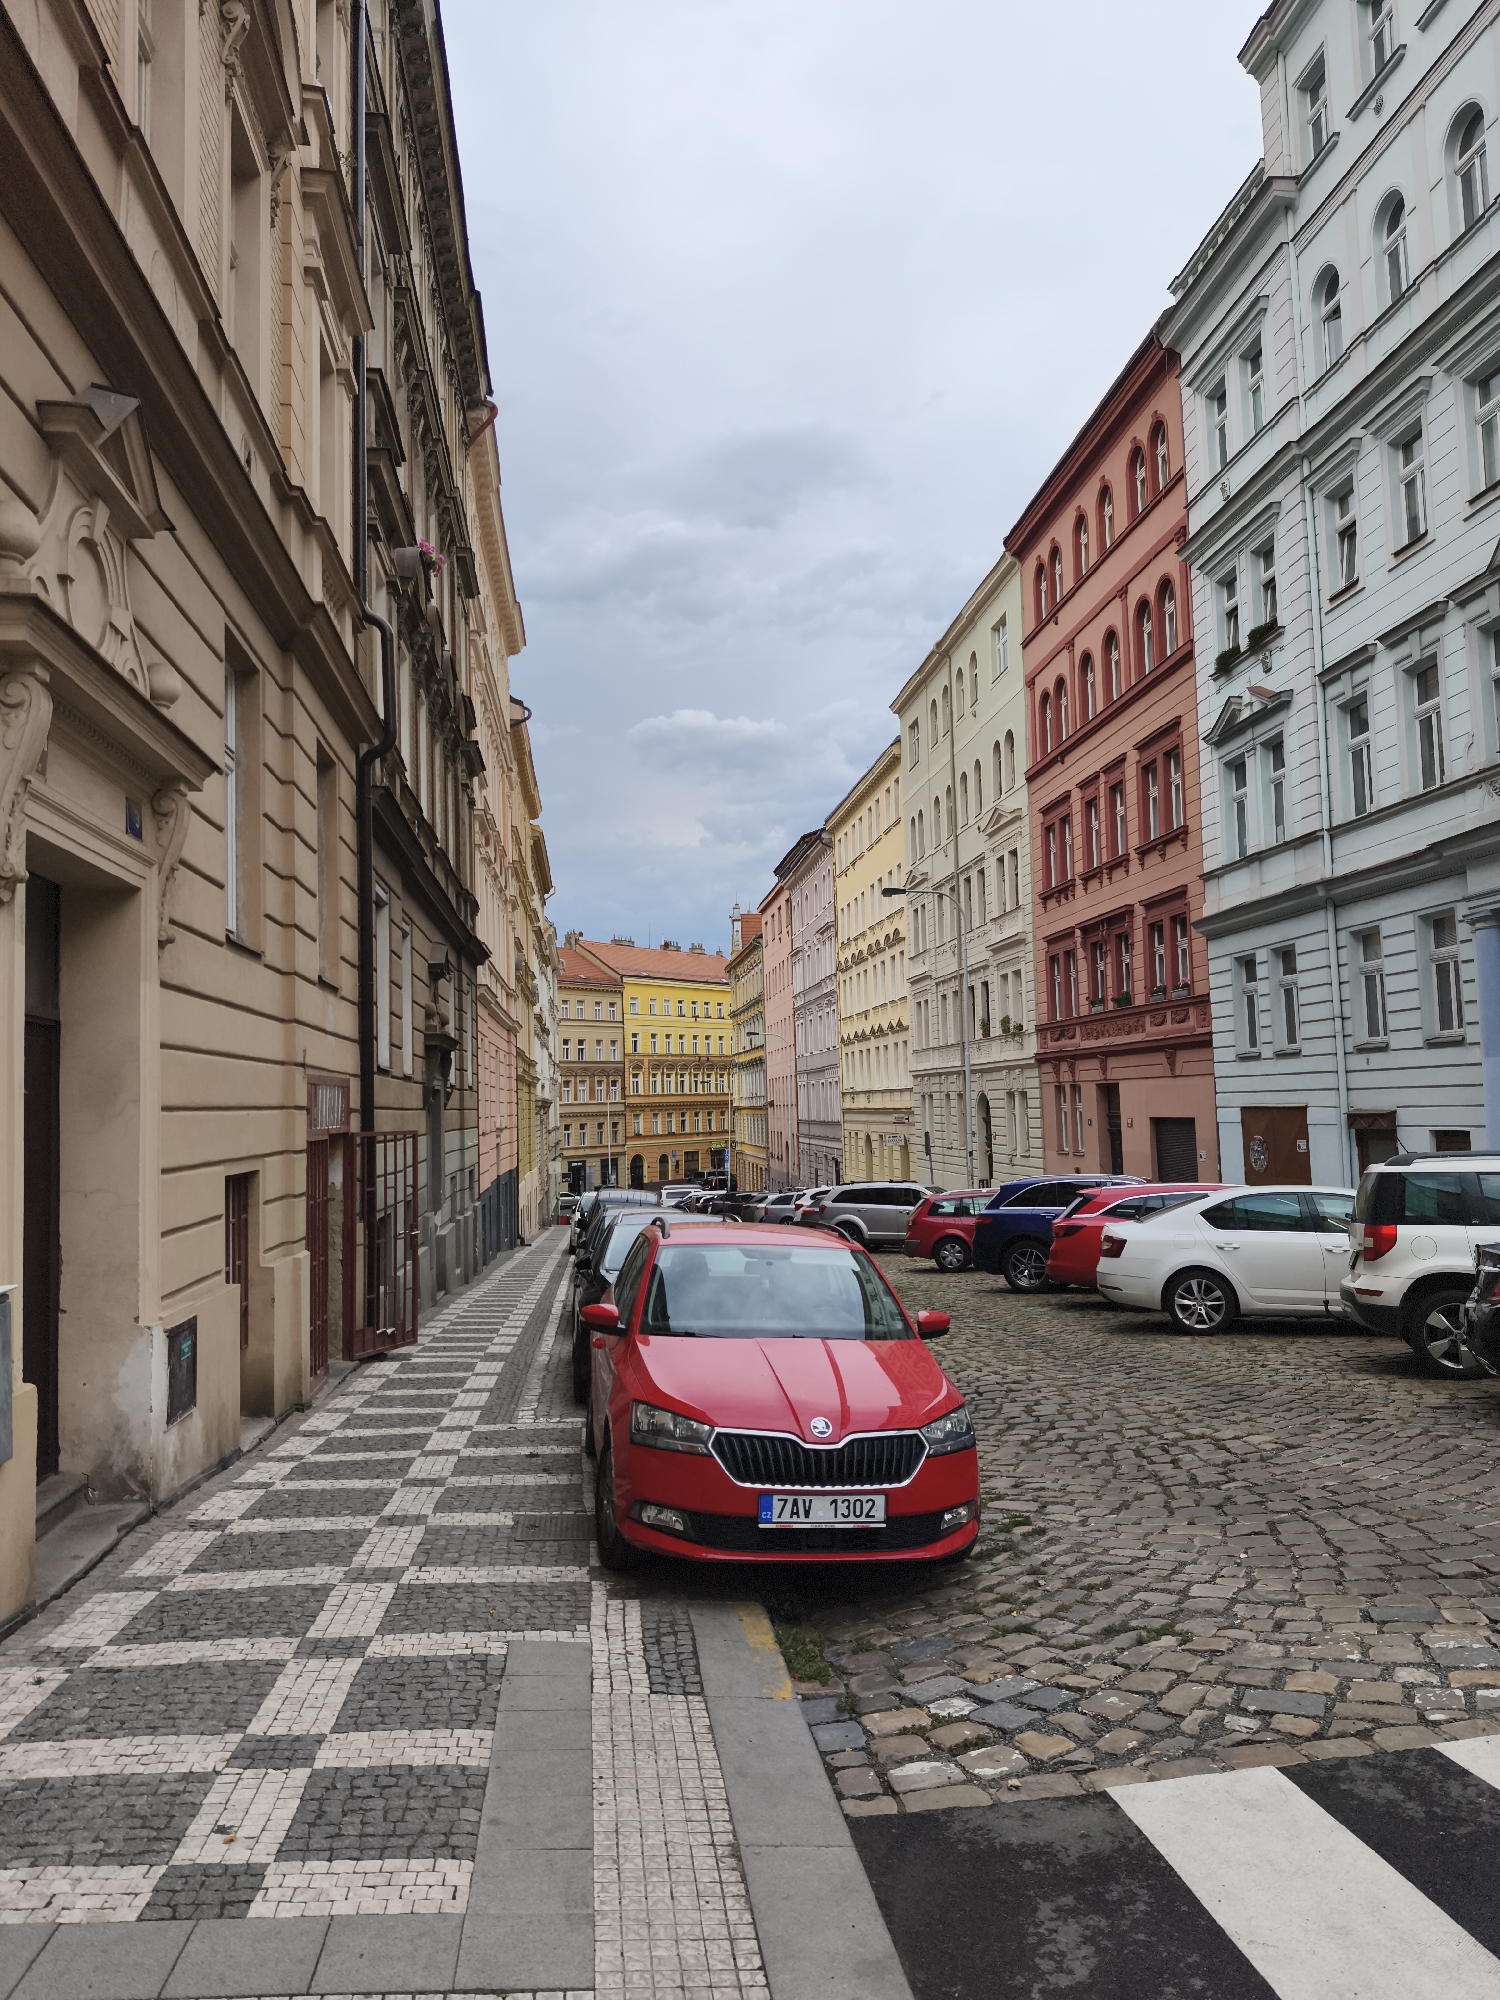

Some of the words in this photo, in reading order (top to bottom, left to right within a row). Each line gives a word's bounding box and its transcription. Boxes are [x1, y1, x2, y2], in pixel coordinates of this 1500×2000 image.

[761, 1511, 772, 1519] CZ
[777, 1498, 813, 1519] 7AV
[829, 1498, 876, 1519] 1302
